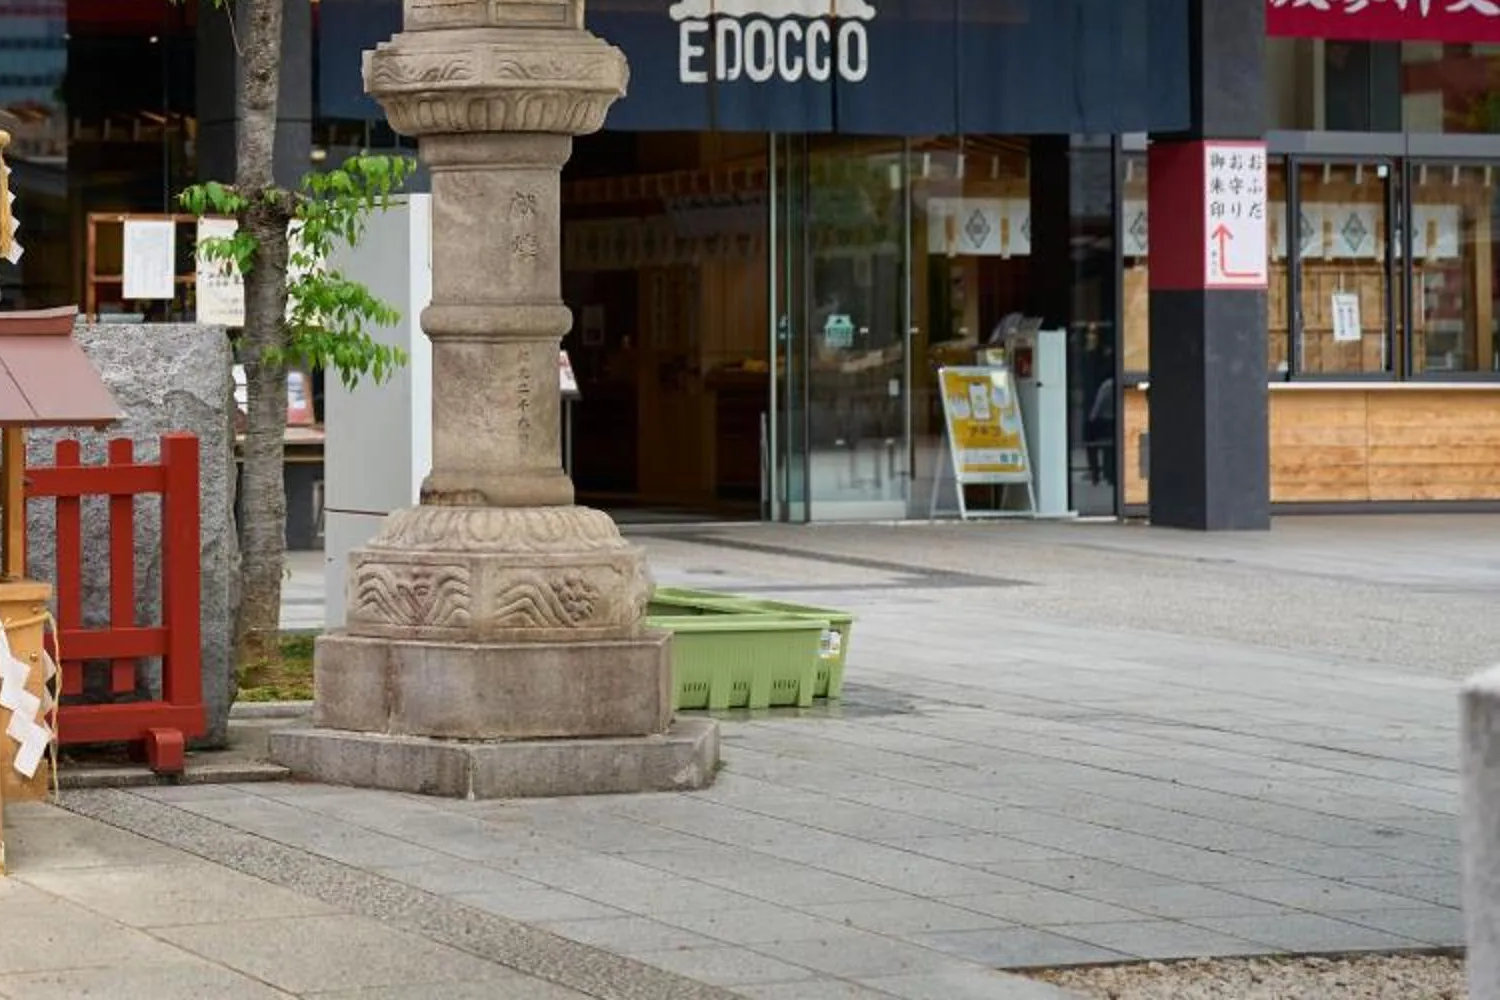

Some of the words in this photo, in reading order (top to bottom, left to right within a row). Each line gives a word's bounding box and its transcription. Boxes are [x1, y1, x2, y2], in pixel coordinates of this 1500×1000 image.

[679, 18, 869, 83] EDOCCO
[1229, 153, 1243, 218] お守り
